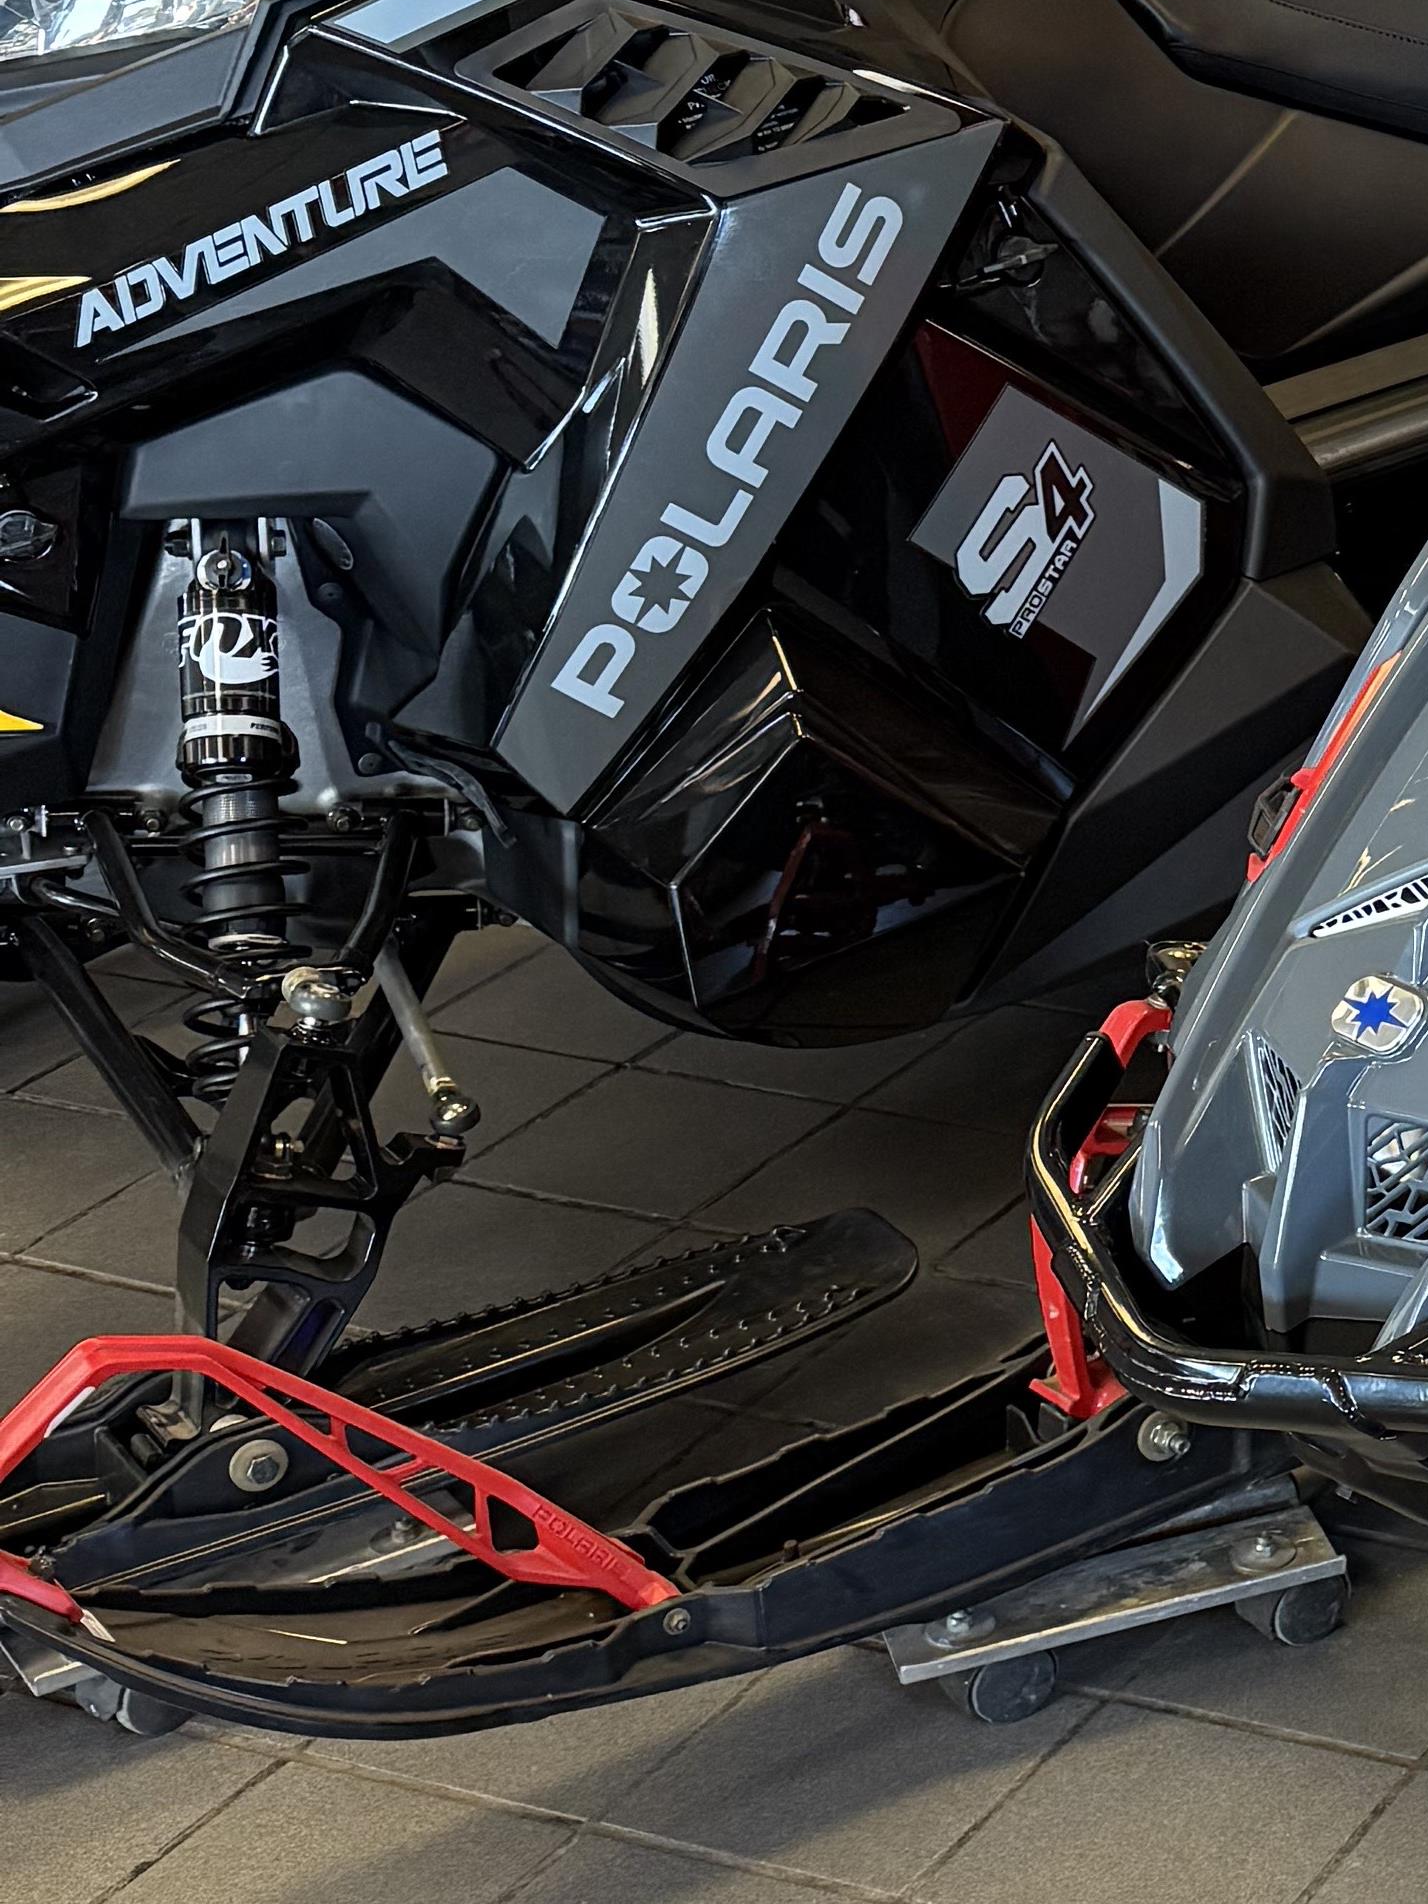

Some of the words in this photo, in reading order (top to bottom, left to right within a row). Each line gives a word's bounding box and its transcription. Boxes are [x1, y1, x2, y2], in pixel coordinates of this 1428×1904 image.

[74, 129, 450, 349] ADVENTURE
[550, 182, 904, 720] POLARIS
[955, 438, 1097, 629] S4
[1008, 536, 1081, 642] PROSTAR
